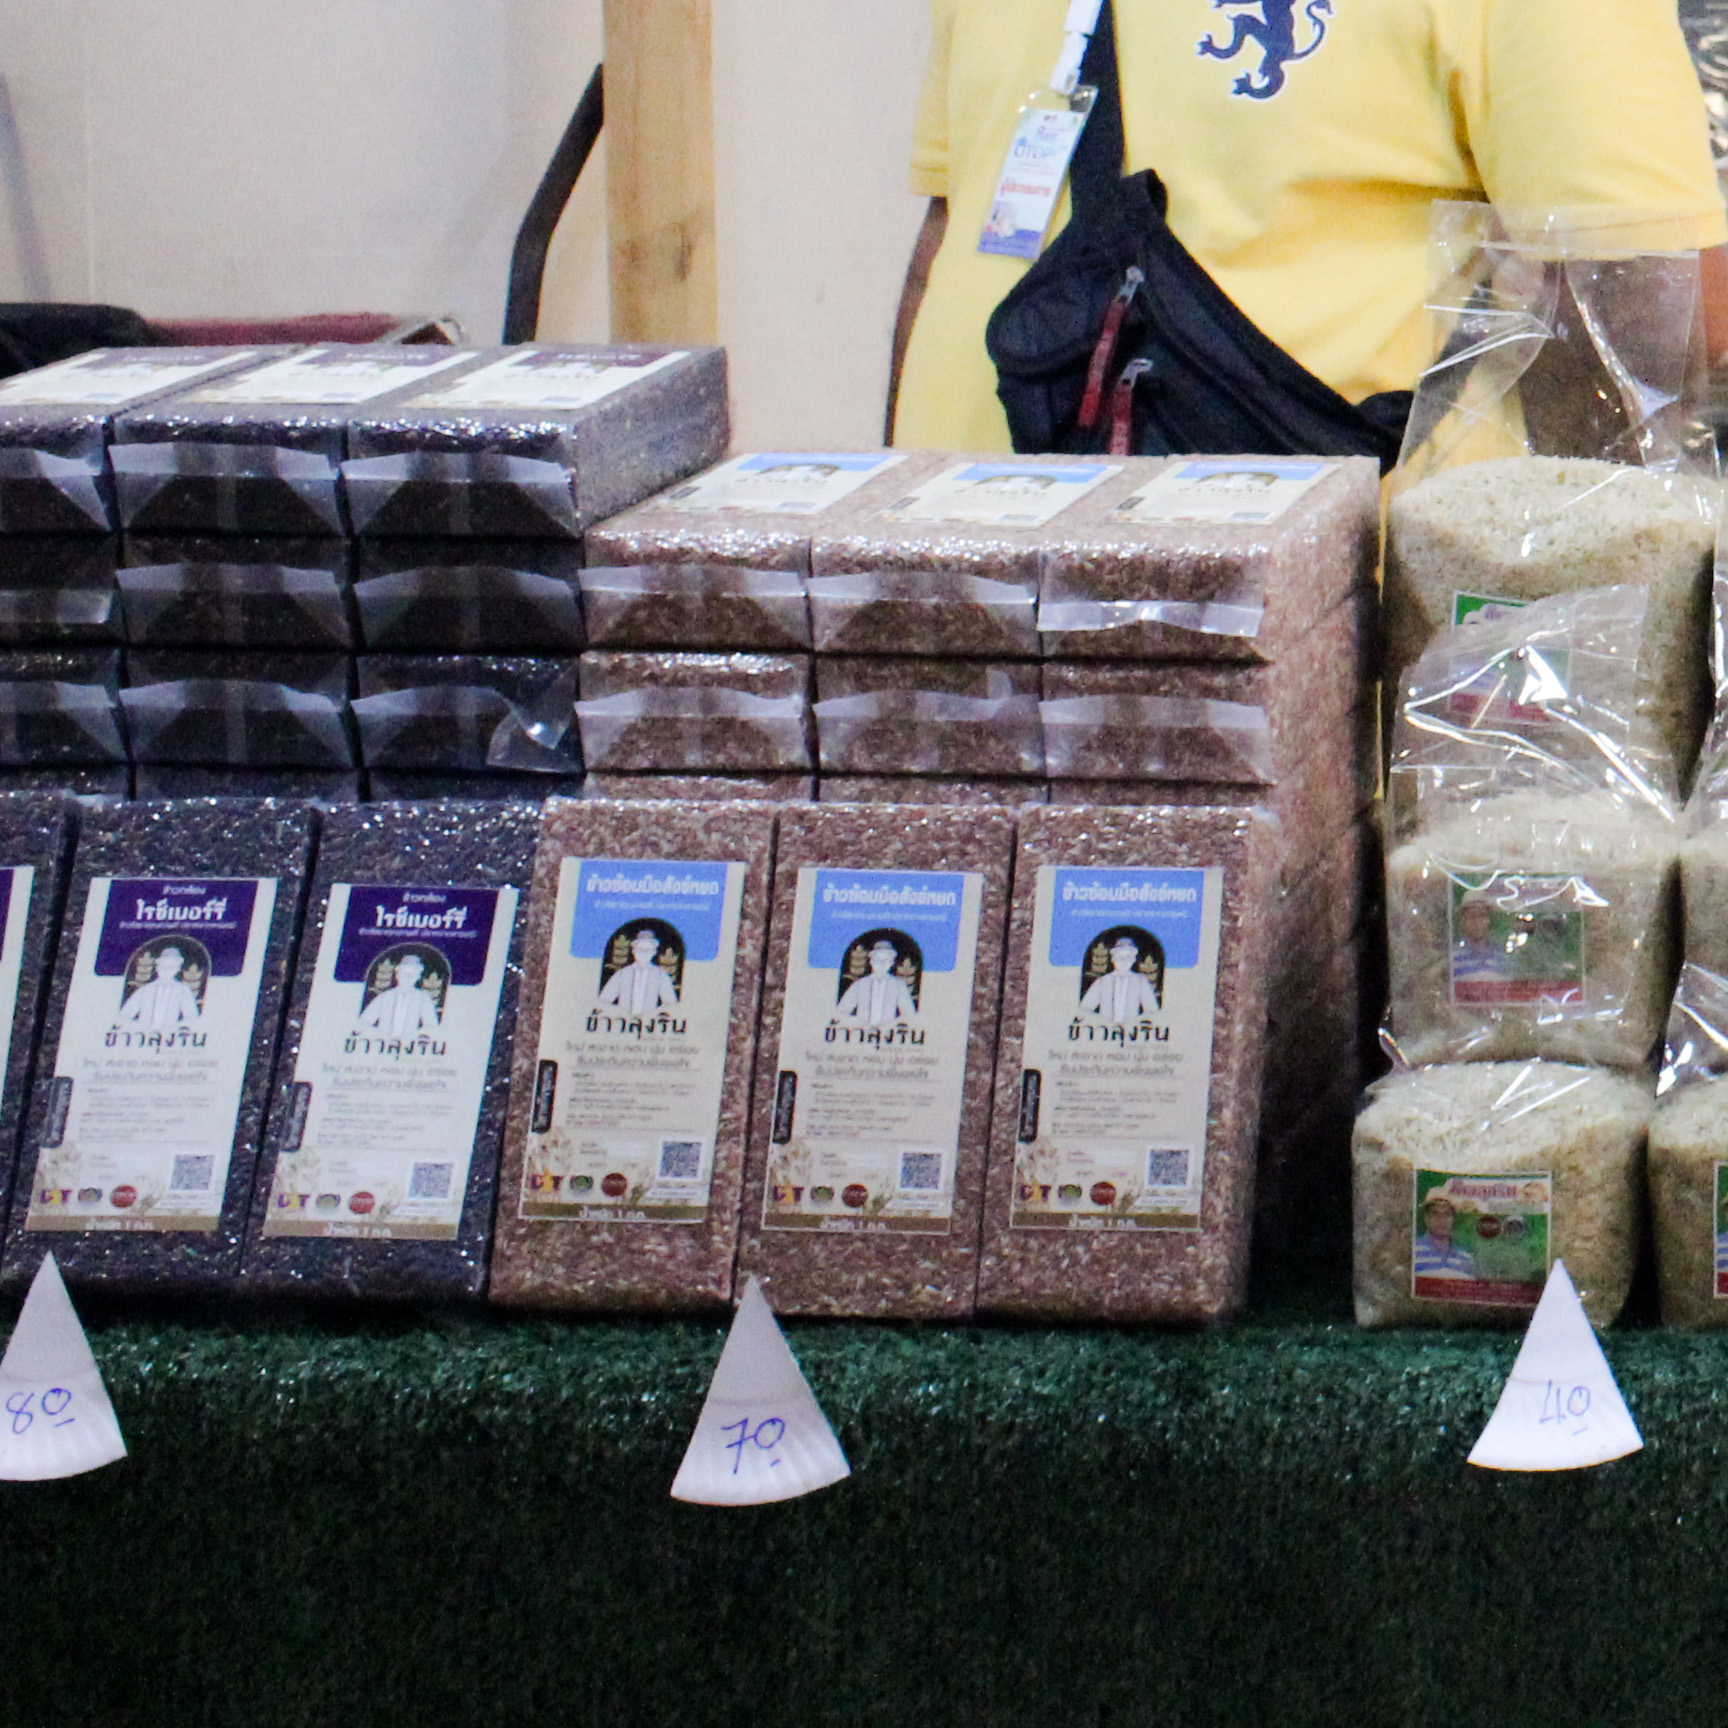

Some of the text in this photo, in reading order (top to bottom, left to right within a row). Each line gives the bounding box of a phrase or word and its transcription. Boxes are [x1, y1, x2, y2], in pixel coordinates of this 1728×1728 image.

[105, 1025, 208, 1054] ข้าวลุงริน
[585, 1008, 686, 1040] ข้าวลุงริน
[824, 1019, 925, 1050] ข้าวลุงริน
[1068, 1017, 1170, 1048] ข้าวลุงริน
[344, 1031, 447, 1061] ข้าวลุงริน
[5, 1387, 73, 1435] 80
[1539, 1380, 1592, 1426] 40
[720, 1416, 787, 1474] 70
